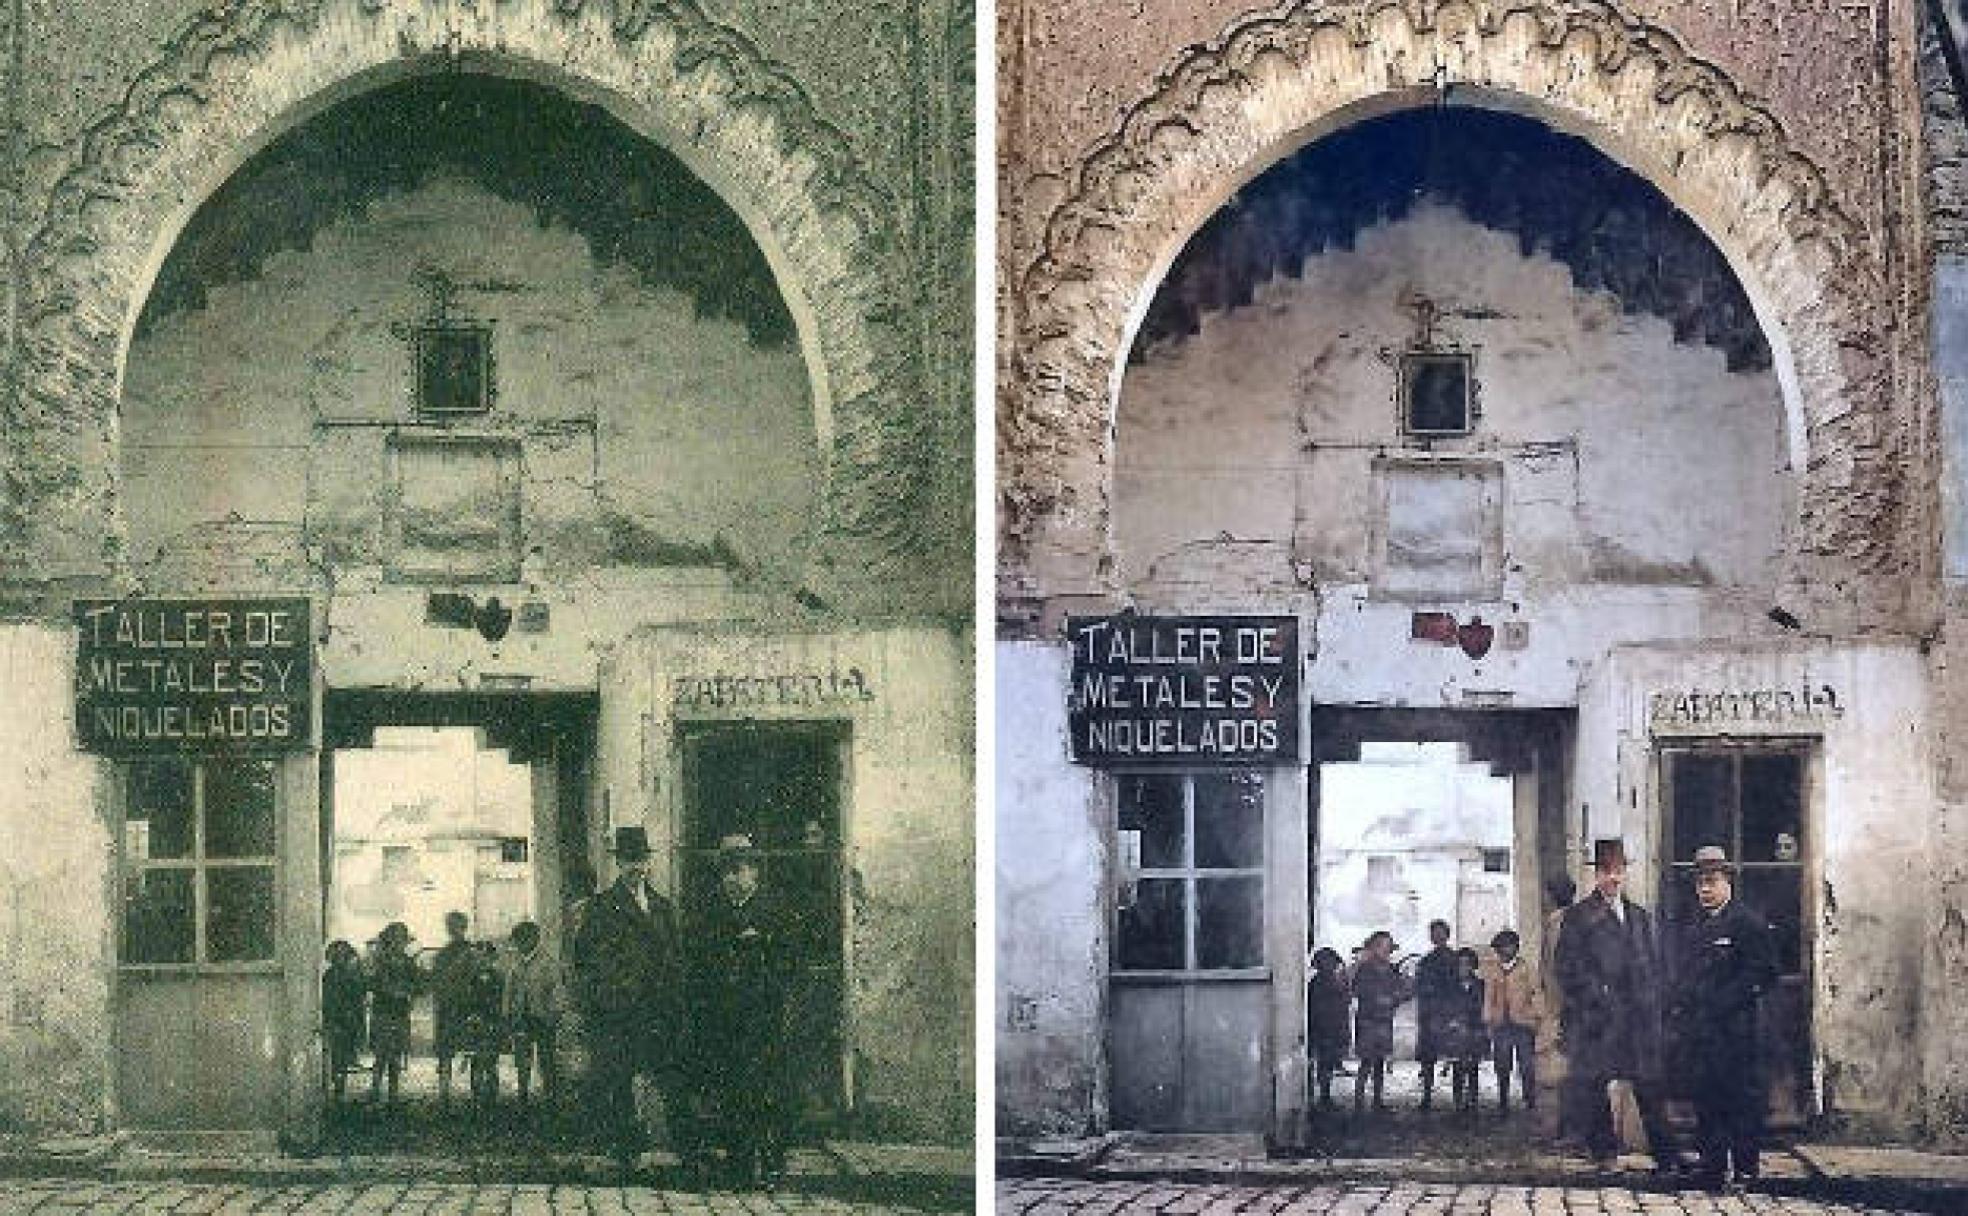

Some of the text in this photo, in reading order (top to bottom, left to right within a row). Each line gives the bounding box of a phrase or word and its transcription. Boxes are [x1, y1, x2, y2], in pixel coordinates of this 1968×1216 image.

[85, 605, 293, 648] TALLER DE
[1080, 621, 1283, 664] TALLER DE
[95, 703, 291, 739] NIQUELADOS
[1088, 718, 1278, 755] NIQUELADOS
